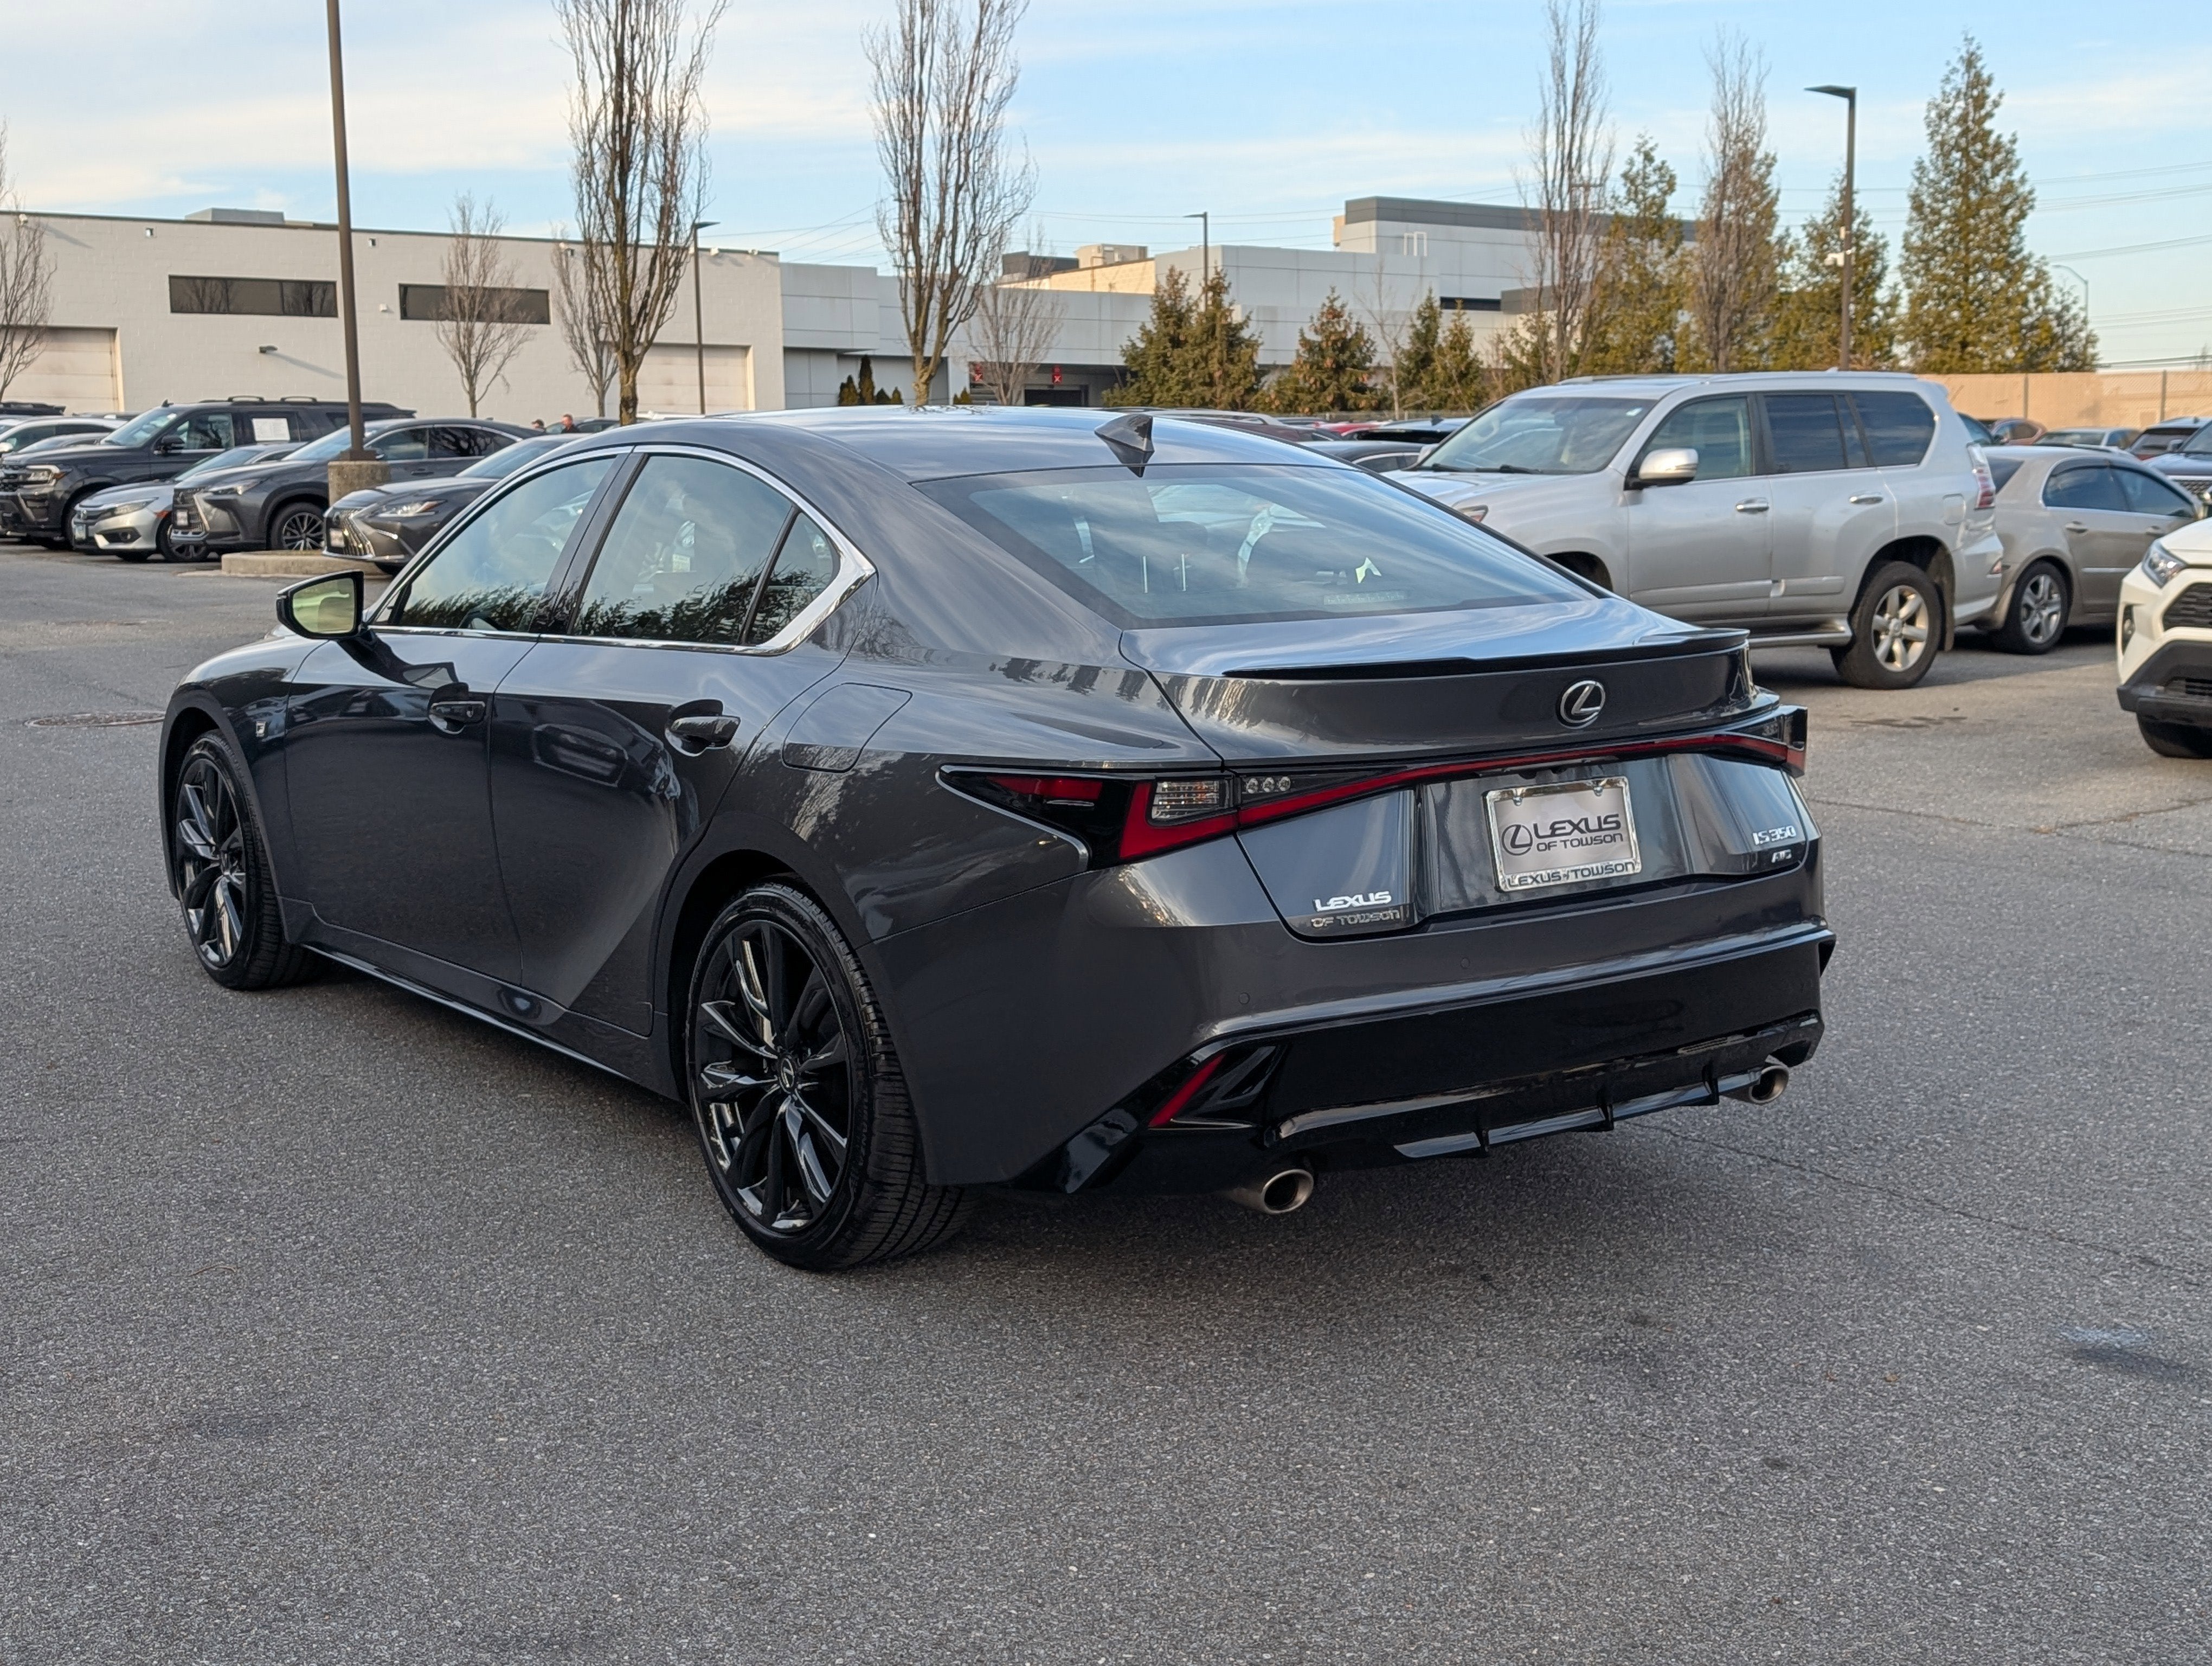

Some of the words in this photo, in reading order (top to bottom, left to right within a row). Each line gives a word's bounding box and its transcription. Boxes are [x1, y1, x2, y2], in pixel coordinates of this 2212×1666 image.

[1533, 814, 1621, 839] LEXUS
[1536, 841, 1557, 852] OF
[1560, 832, 1624, 849] TOWSON
[1508, 871, 1561, 888] LEXUS
[1570, 862, 1635, 879] TOWSON
[1313, 891, 1392, 912] LEXUS
[1311, 917, 1334, 928] OF
[1337, 909, 1400, 925] TOWSON
